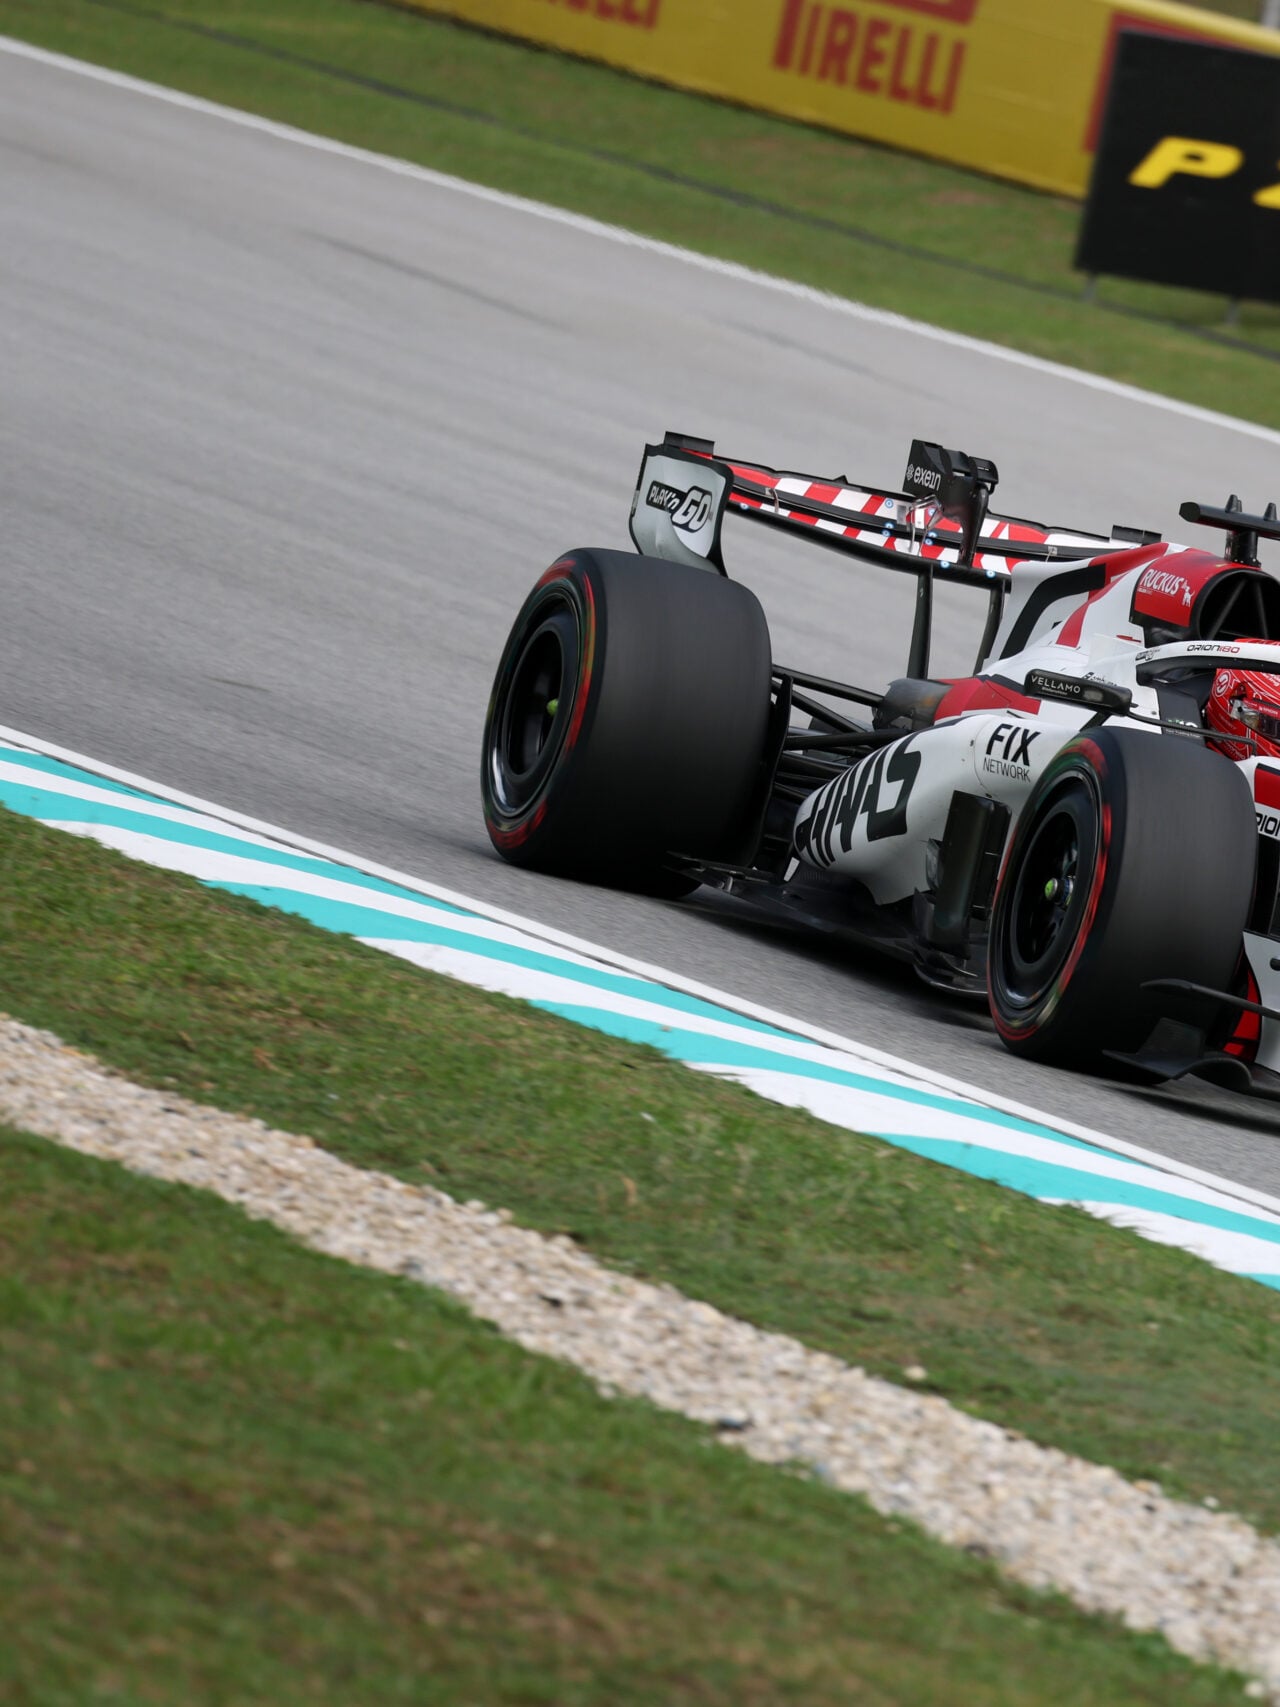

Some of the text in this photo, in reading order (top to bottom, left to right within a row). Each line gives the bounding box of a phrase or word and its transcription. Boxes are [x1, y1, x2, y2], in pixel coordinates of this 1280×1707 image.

[1127, 136, 1244, 190] P
[671, 487, 712, 532] GO
[1140, 569, 1185, 595] RUCKUS
[1031, 674, 1081, 694] VELLAMO
[986, 723, 1042, 767] FIX
[982, 756, 1031, 783] NETWORK
[795, 731, 922, 870] HAAS
